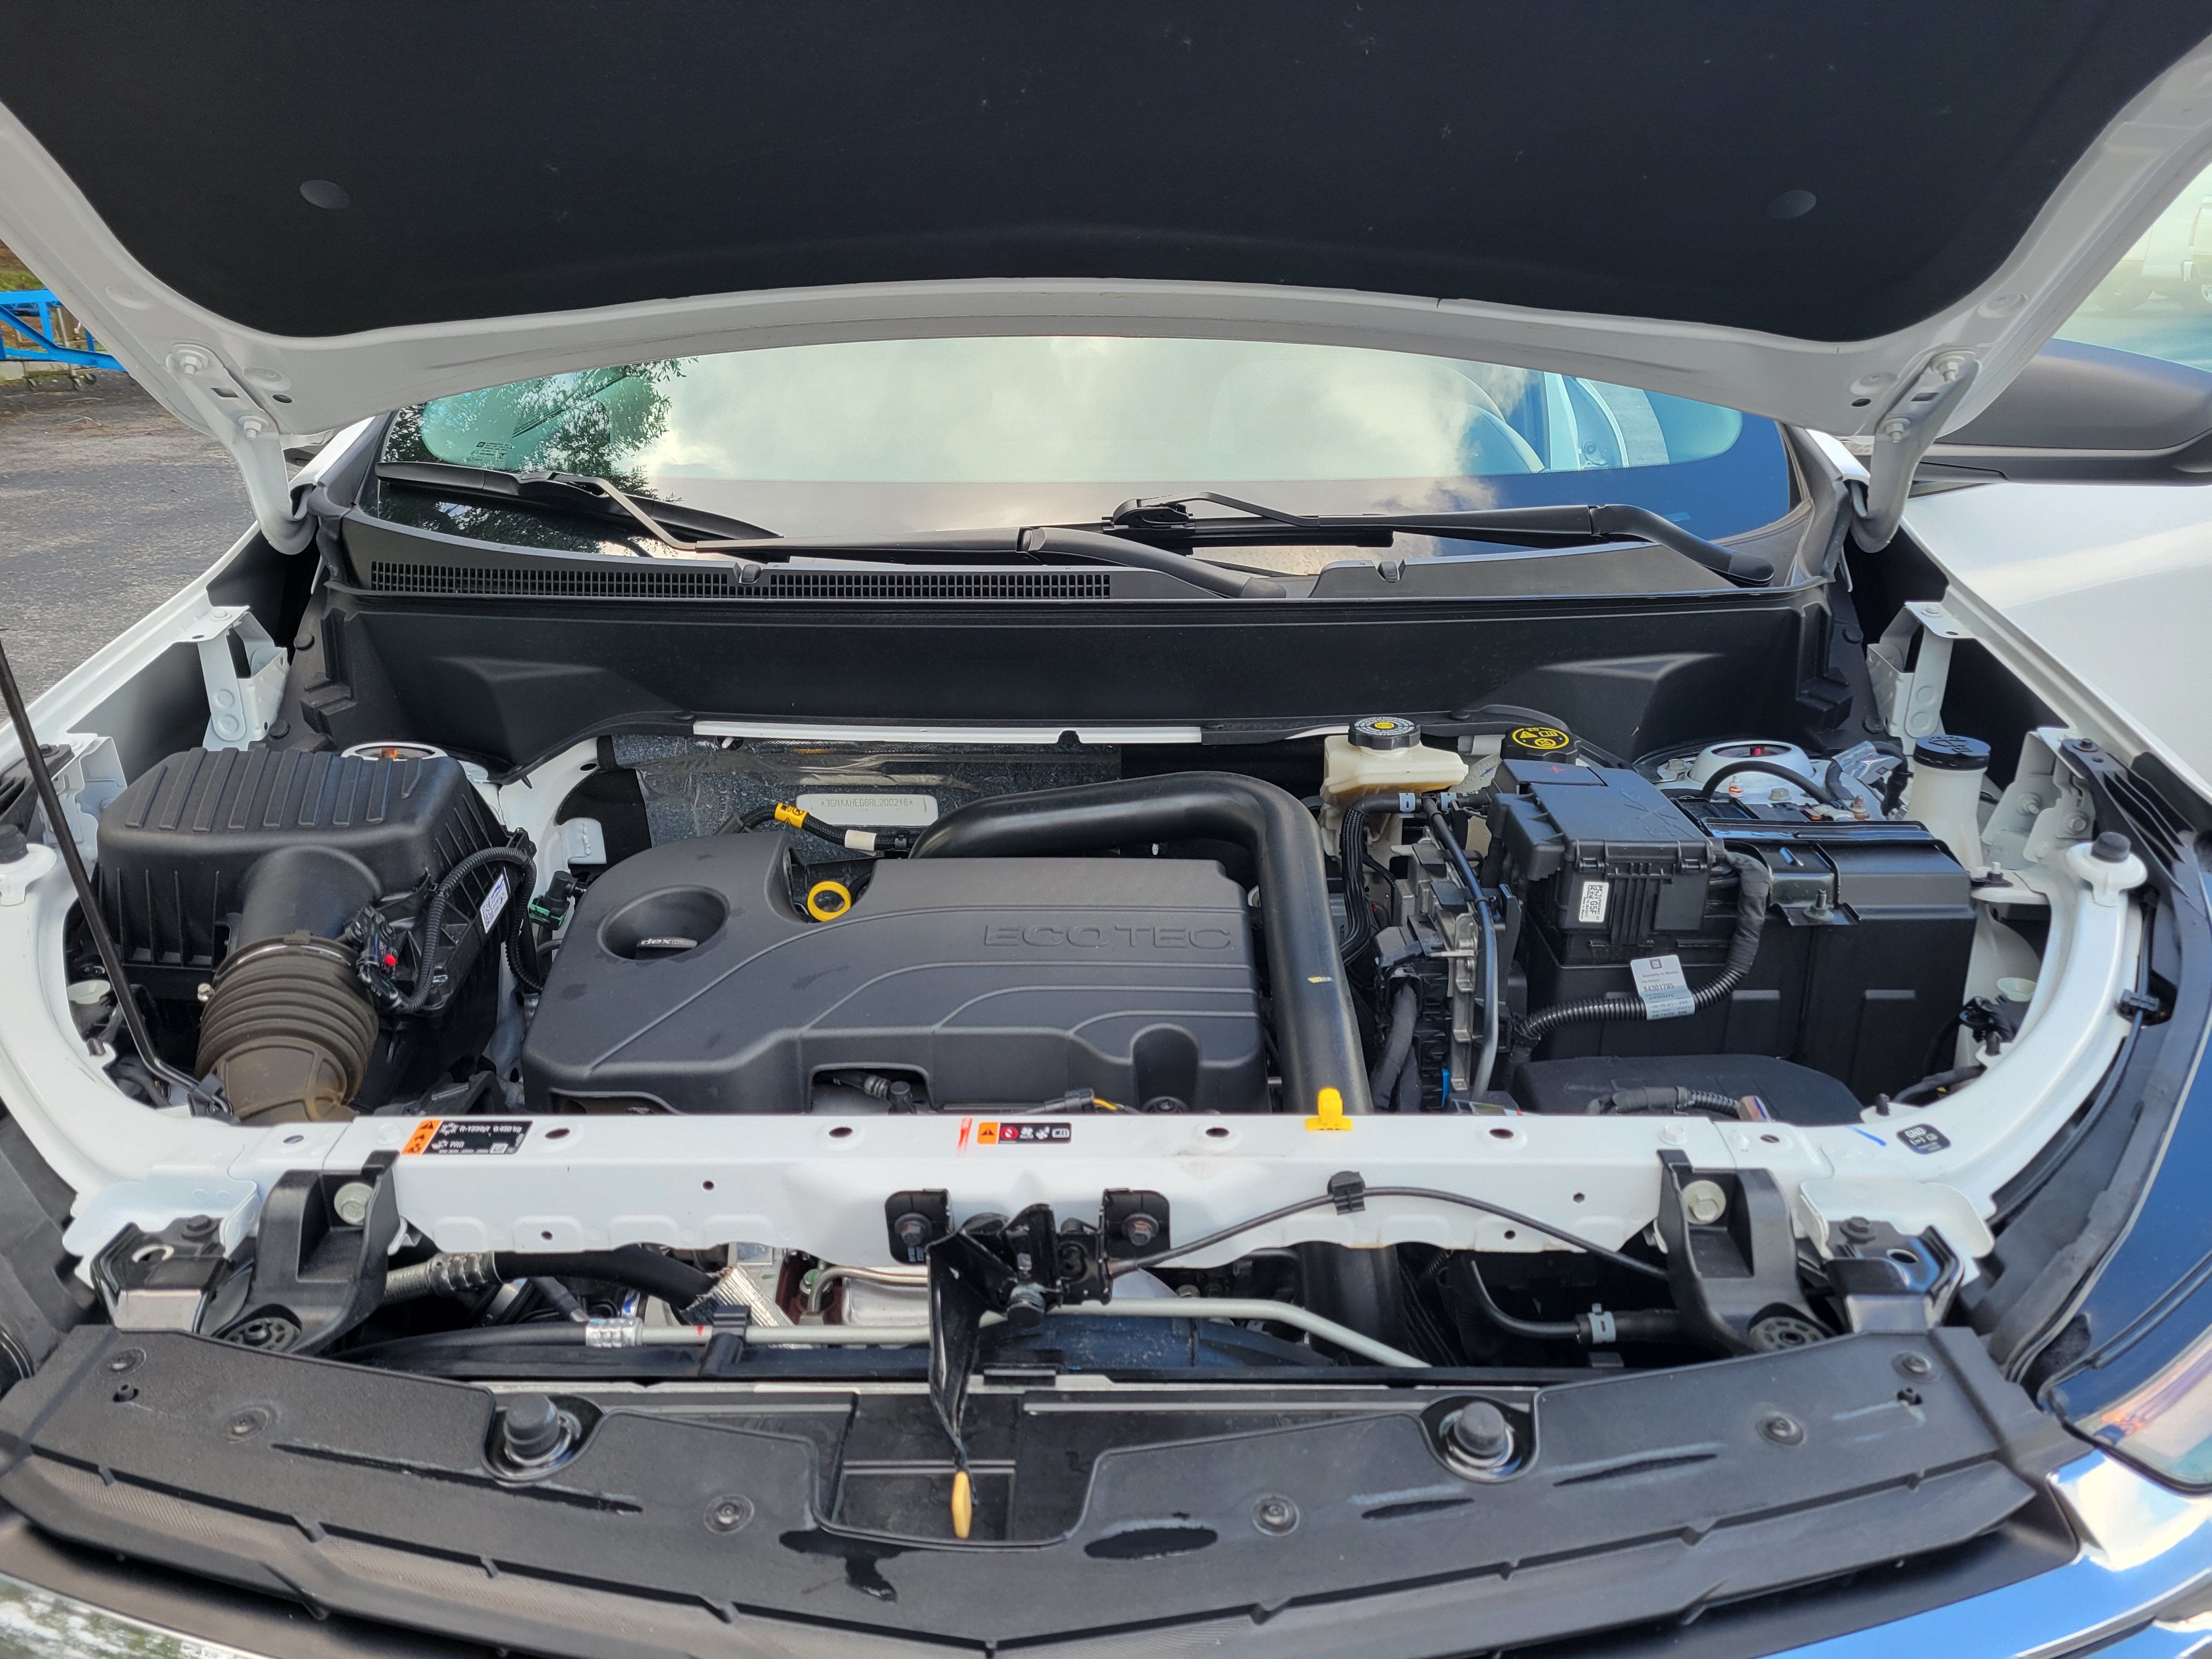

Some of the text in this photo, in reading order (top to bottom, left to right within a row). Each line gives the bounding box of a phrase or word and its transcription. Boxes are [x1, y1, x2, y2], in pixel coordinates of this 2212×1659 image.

[1589, 901, 1598, 915] G5F
[984, 924, 1231, 950] ECOTEC
[1643, 983, 1674, 992] 84301795
[1905, 1127, 1926, 1139] GND
